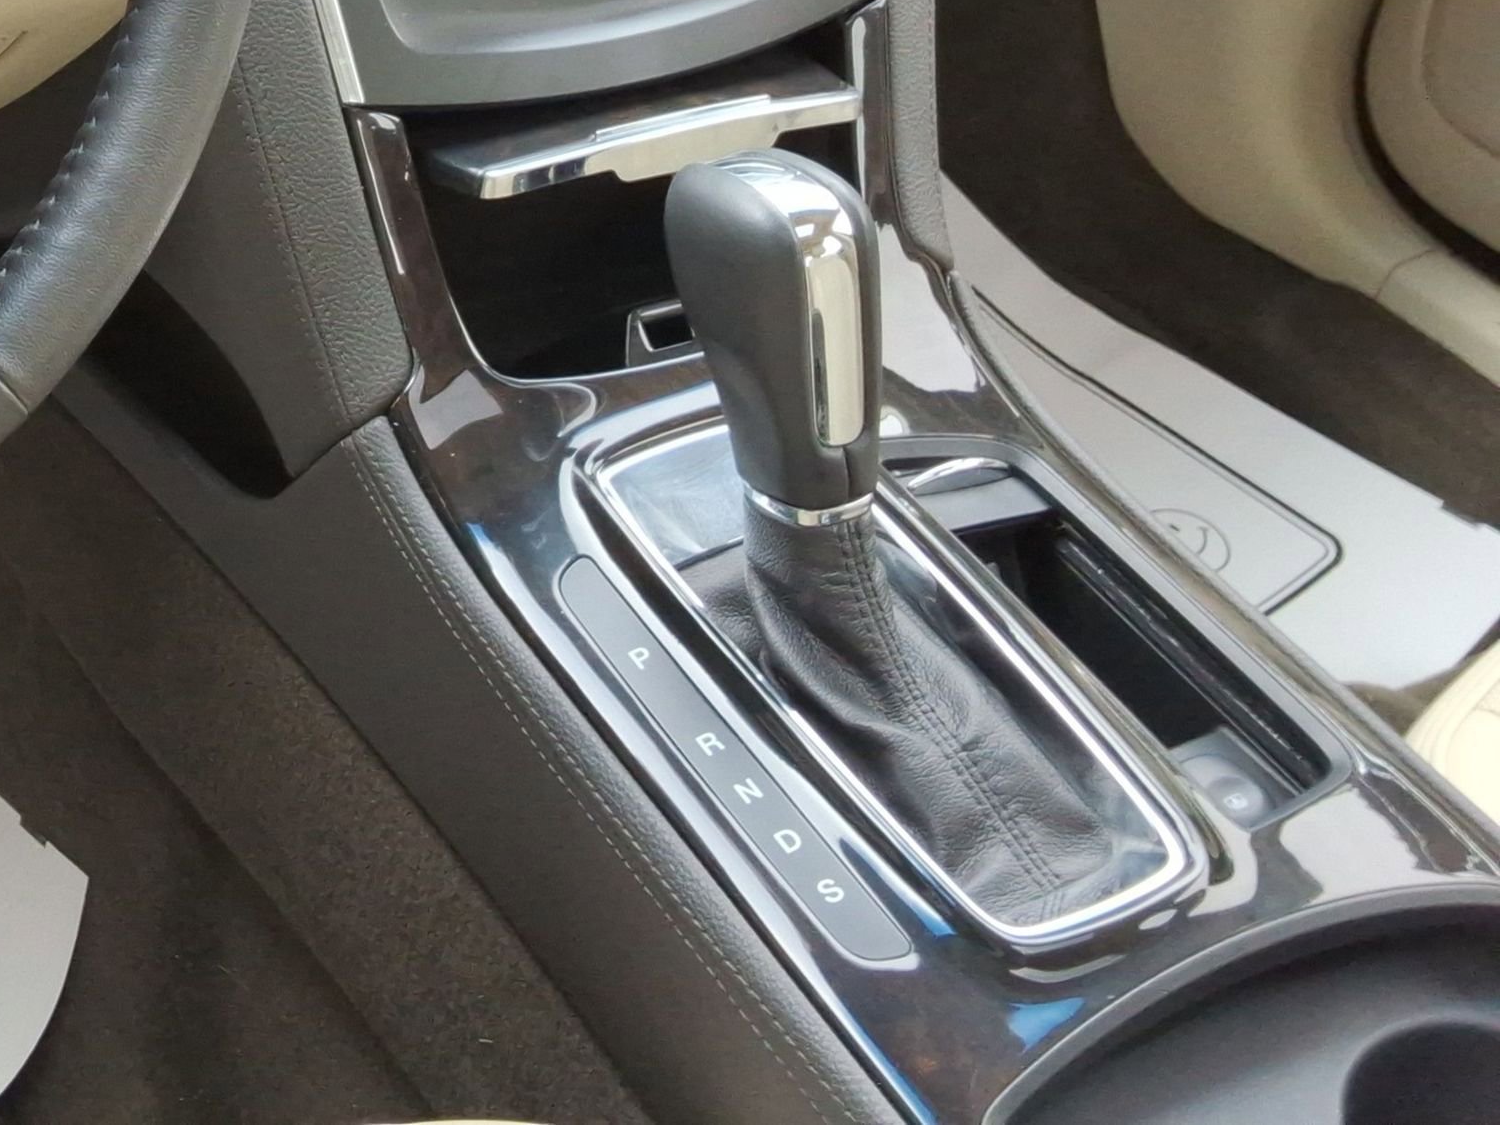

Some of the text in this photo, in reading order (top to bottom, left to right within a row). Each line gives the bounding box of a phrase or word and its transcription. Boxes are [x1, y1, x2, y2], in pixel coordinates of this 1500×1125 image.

[627, 647, 650, 670] P
[695, 732, 725, 756] R
[733, 778, 765, 804] N
[773, 829, 802, 854] D
[816, 878, 845, 903] S
